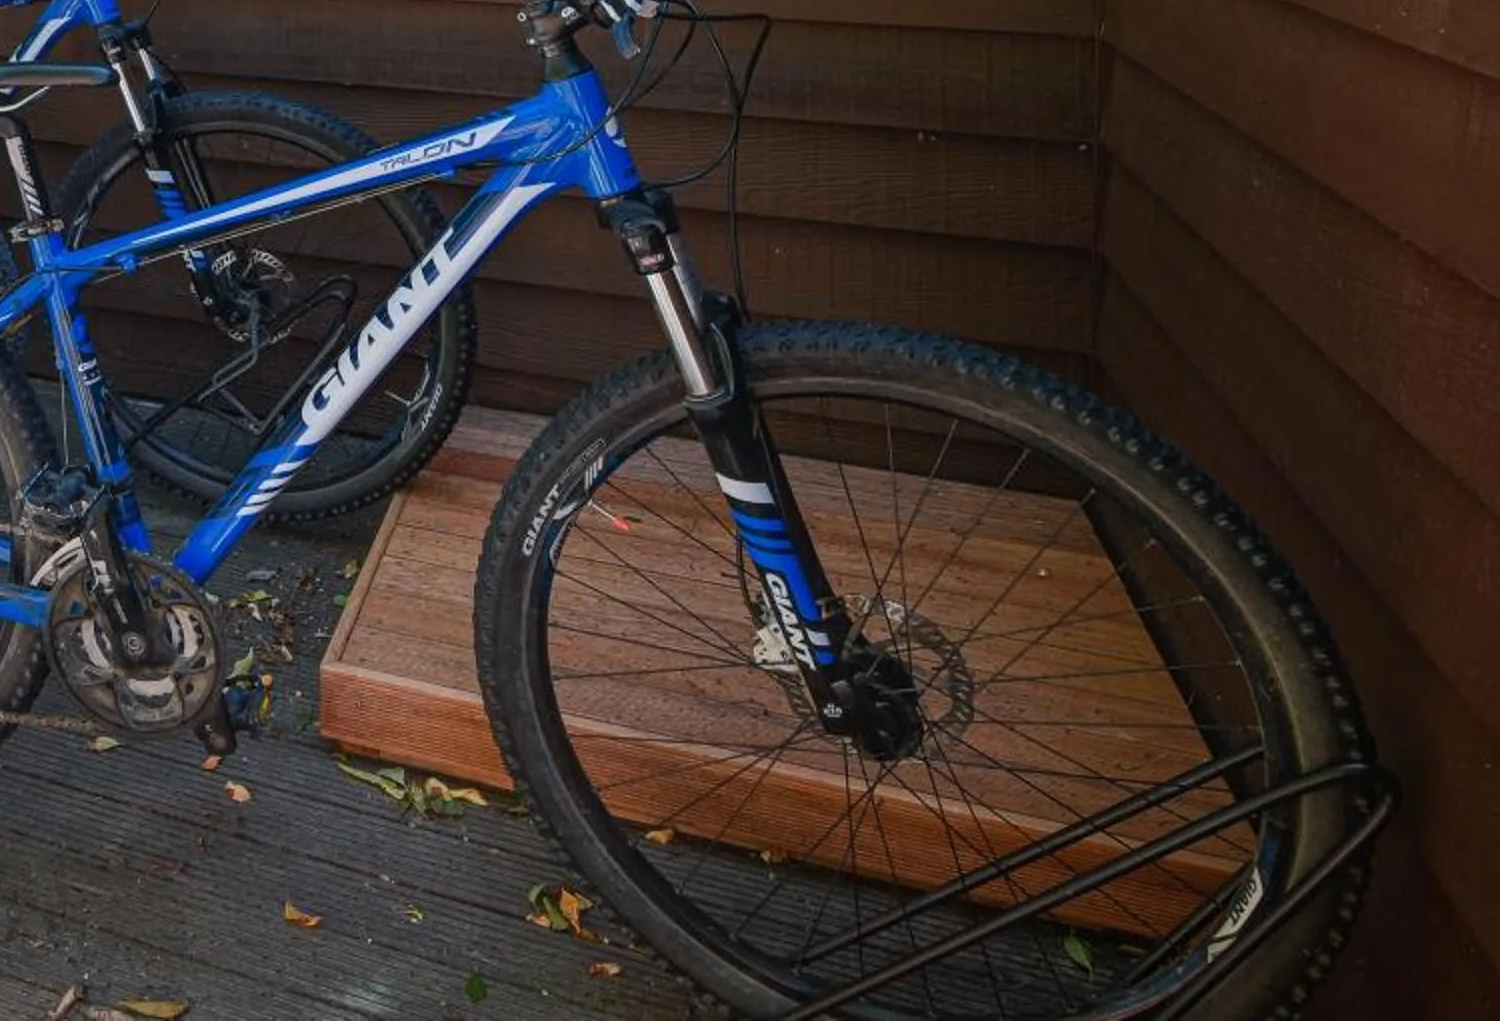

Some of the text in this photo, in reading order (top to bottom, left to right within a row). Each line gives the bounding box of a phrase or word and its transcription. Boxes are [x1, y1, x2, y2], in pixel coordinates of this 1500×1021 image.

[379, 131, 477, 172] TALON
[301, 227, 455, 431] GIANT
[522, 483, 560, 556] GIANT
[764, 571, 818, 671] GIANT
